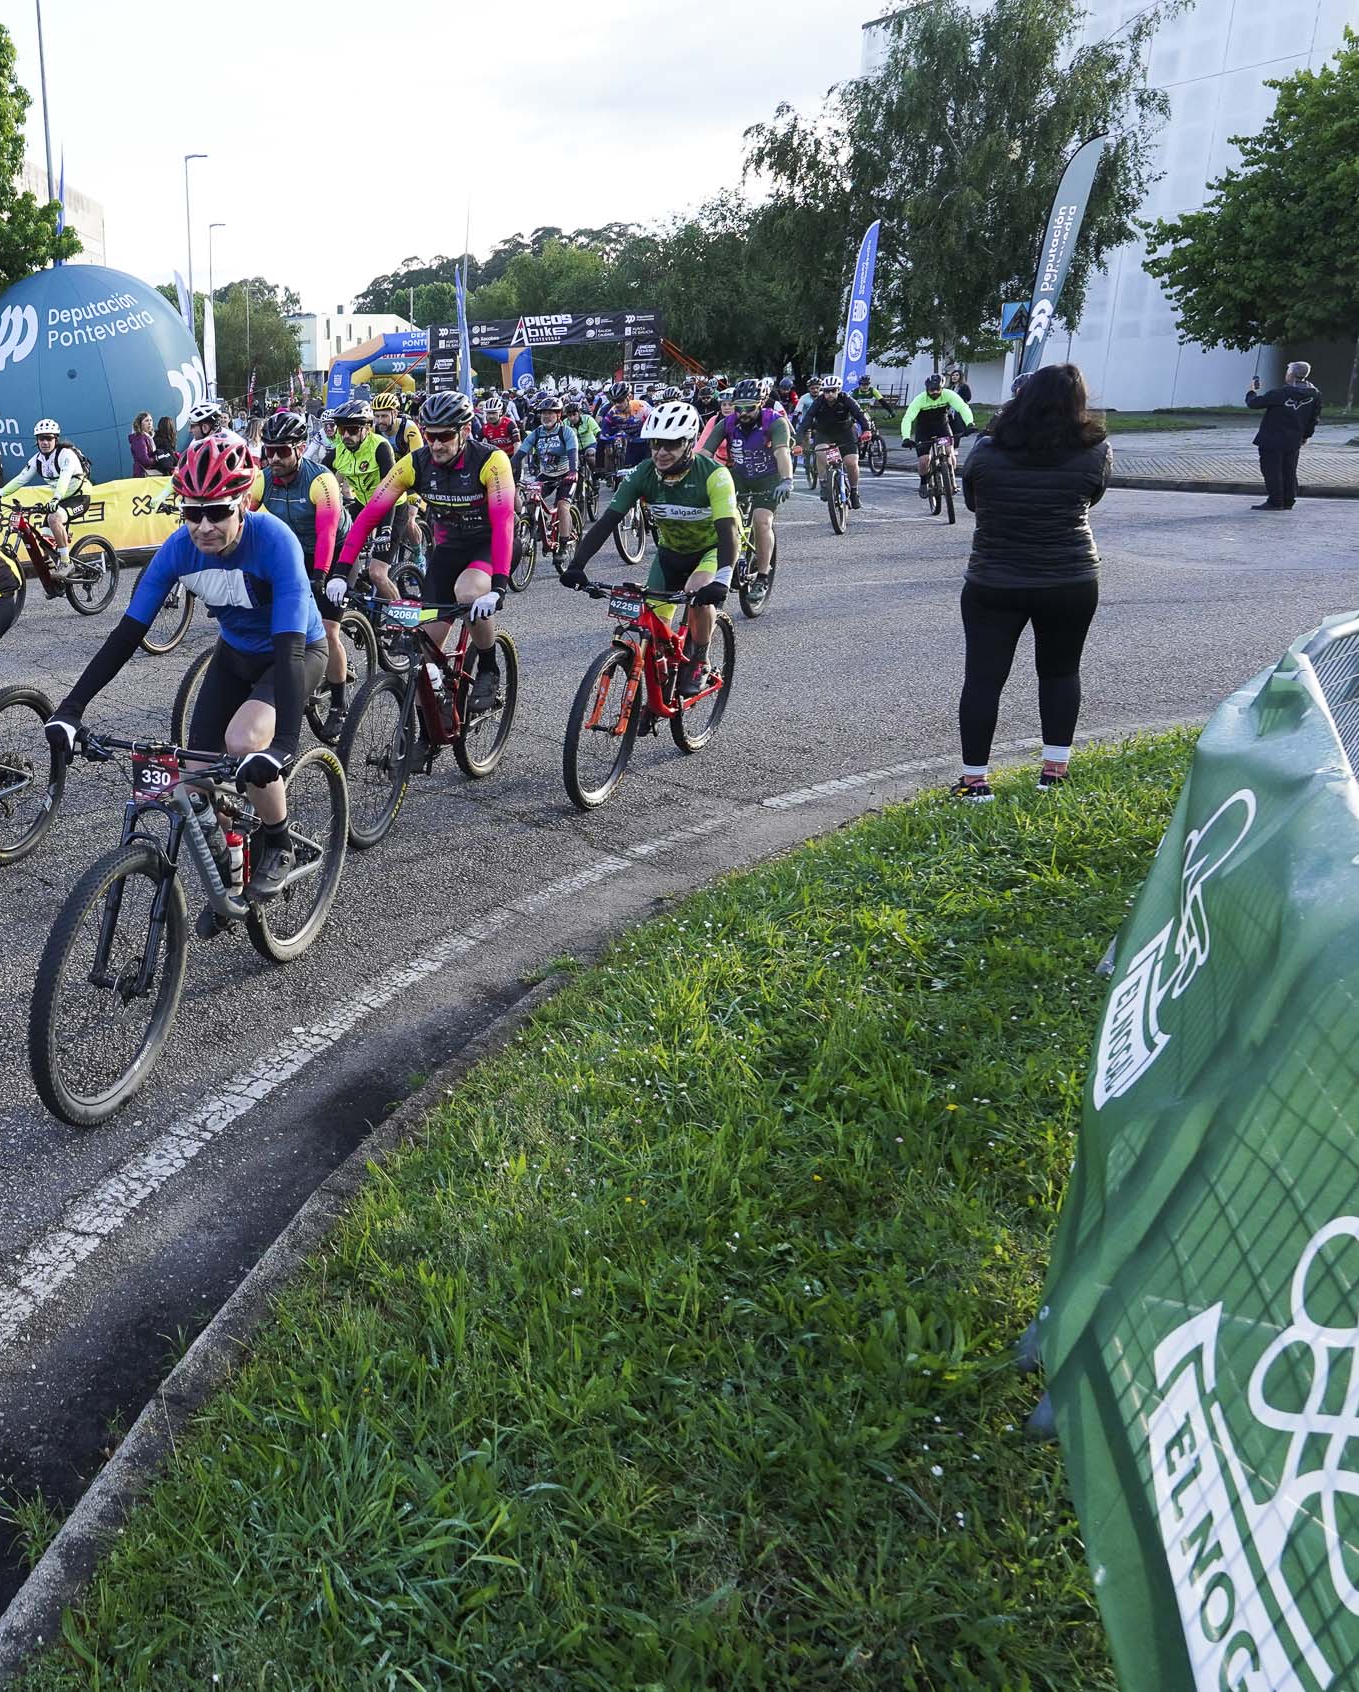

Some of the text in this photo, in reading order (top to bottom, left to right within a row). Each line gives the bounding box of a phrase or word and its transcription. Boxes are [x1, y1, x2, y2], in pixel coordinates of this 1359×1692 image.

[48, 292, 138, 327] Deputación
[525, 314, 573, 328] PICOS
[48, 310, 154, 350] Pontevedra
[670, 507, 702, 517] Salgado
[142, 769, 171, 786] 330
